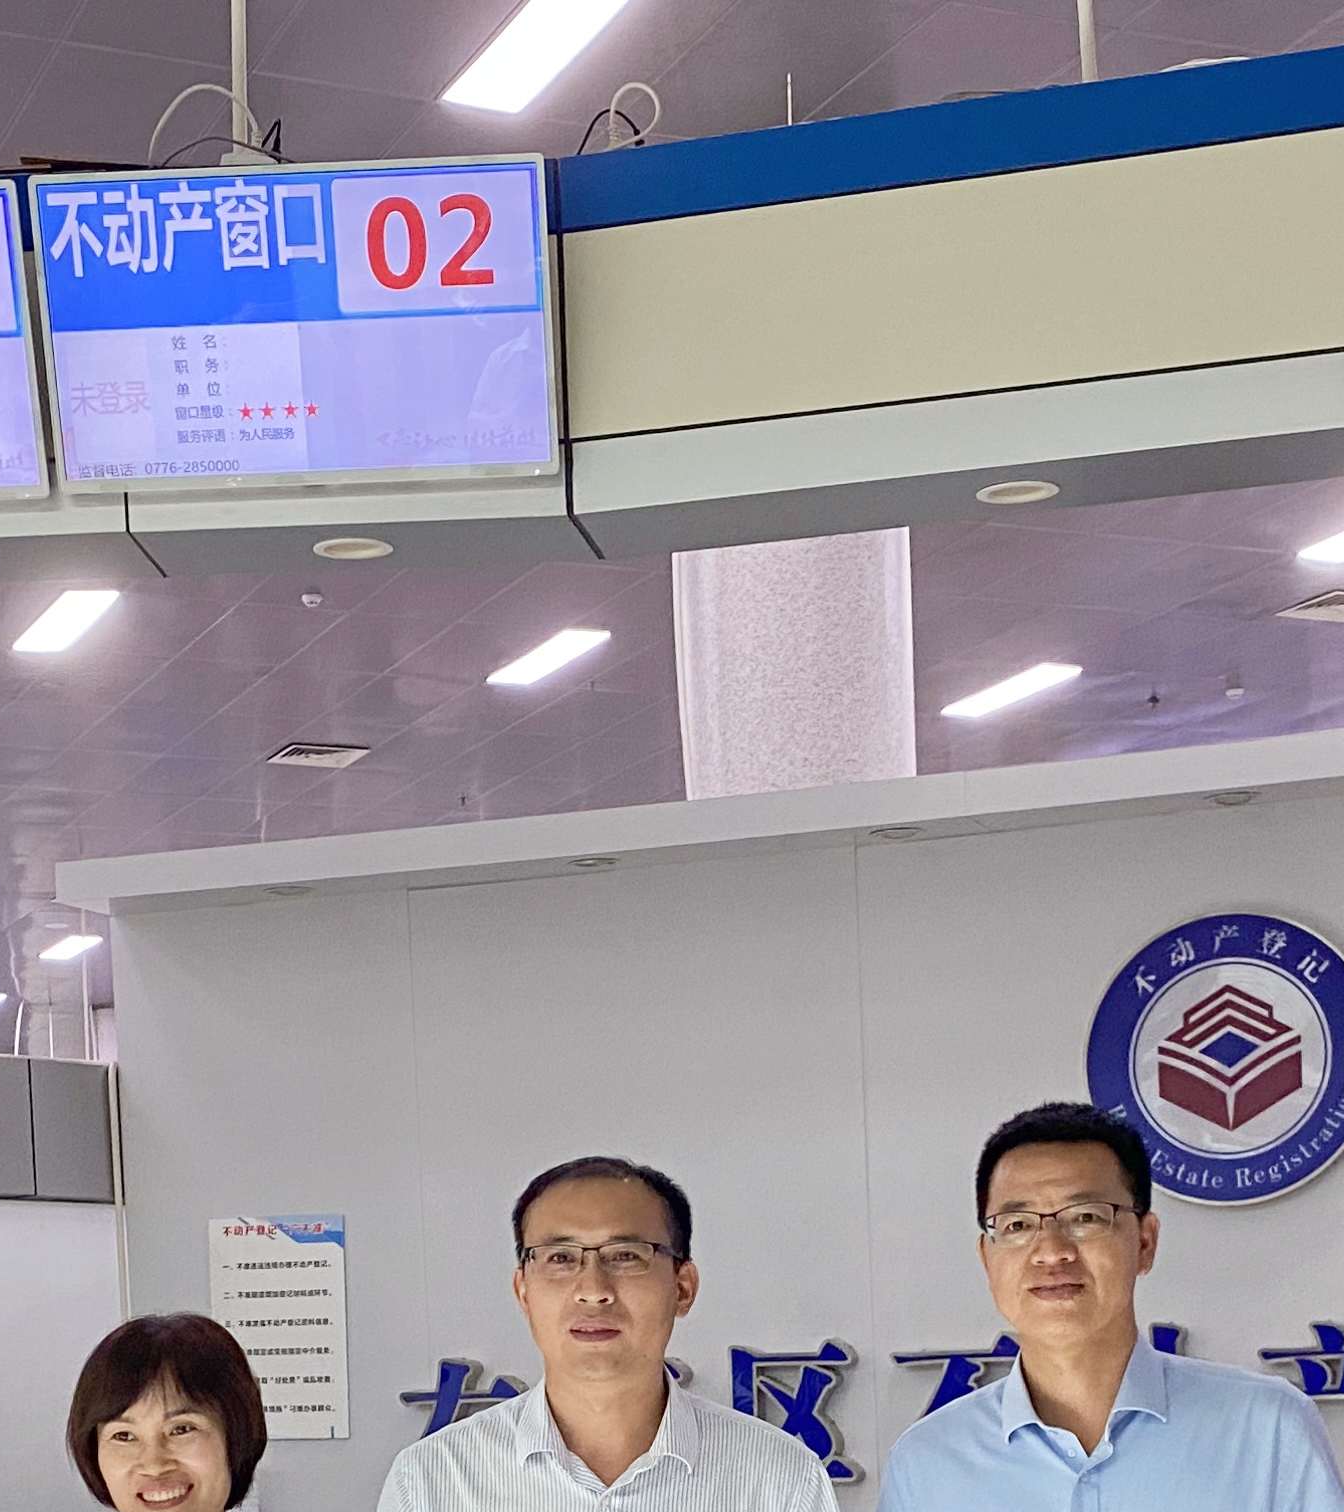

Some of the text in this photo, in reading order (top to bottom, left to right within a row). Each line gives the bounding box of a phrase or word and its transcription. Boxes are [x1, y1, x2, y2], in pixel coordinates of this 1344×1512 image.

[45, 177, 327, 278] 不动产窗口
[365, 192, 496, 292] 02
[69, 379, 152, 417] 未登录
[144, 459, 241, 476] 0776-2850000
[1130, 922, 1331, 998] 不动产登记
[1150, 1146, 1225, 1189] Estate
